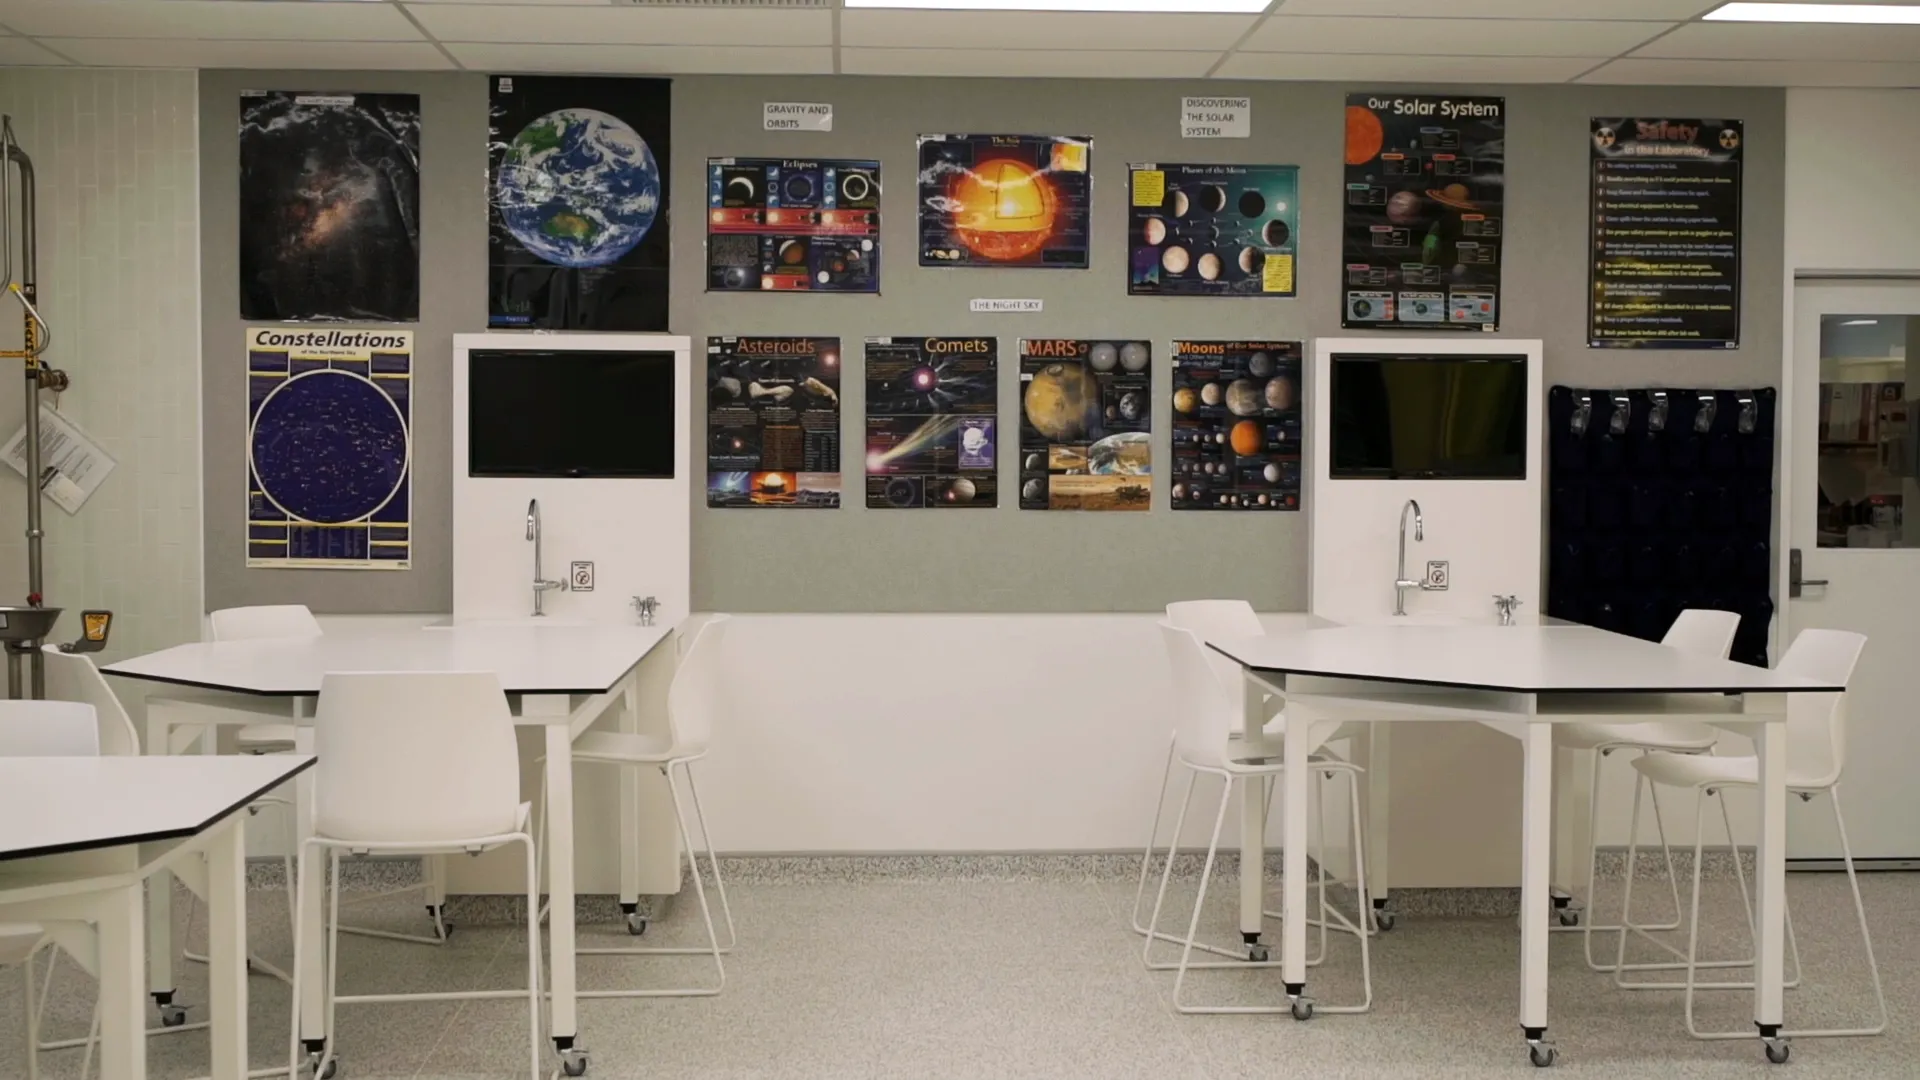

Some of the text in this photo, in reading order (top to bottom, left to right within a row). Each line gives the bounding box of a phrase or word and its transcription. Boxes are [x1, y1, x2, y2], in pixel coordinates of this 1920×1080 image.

[1187, 98, 1247, 109] DISCOVERING
[1366, 97, 1498, 120] Our Solar System
[767, 105, 828, 115] GRAVITY AND
[1187, 112, 1234, 122] THE SOLAR
[767, 119, 799, 129] ORBITS
[1186, 127, 1220, 136] SYSTEM
[1636, 120, 1698, 145] Safety
[783, 159, 818, 170] Eclipses
[974, 301, 1040, 309] THE NIGHT SKY
[255, 330, 406, 348] Constellations
[925, 337, 988, 353] Comets
[737, 338, 815, 354] Asteroids
[1027, 340, 1077, 356] MARS
[1178, 341, 1225, 355] Moons
